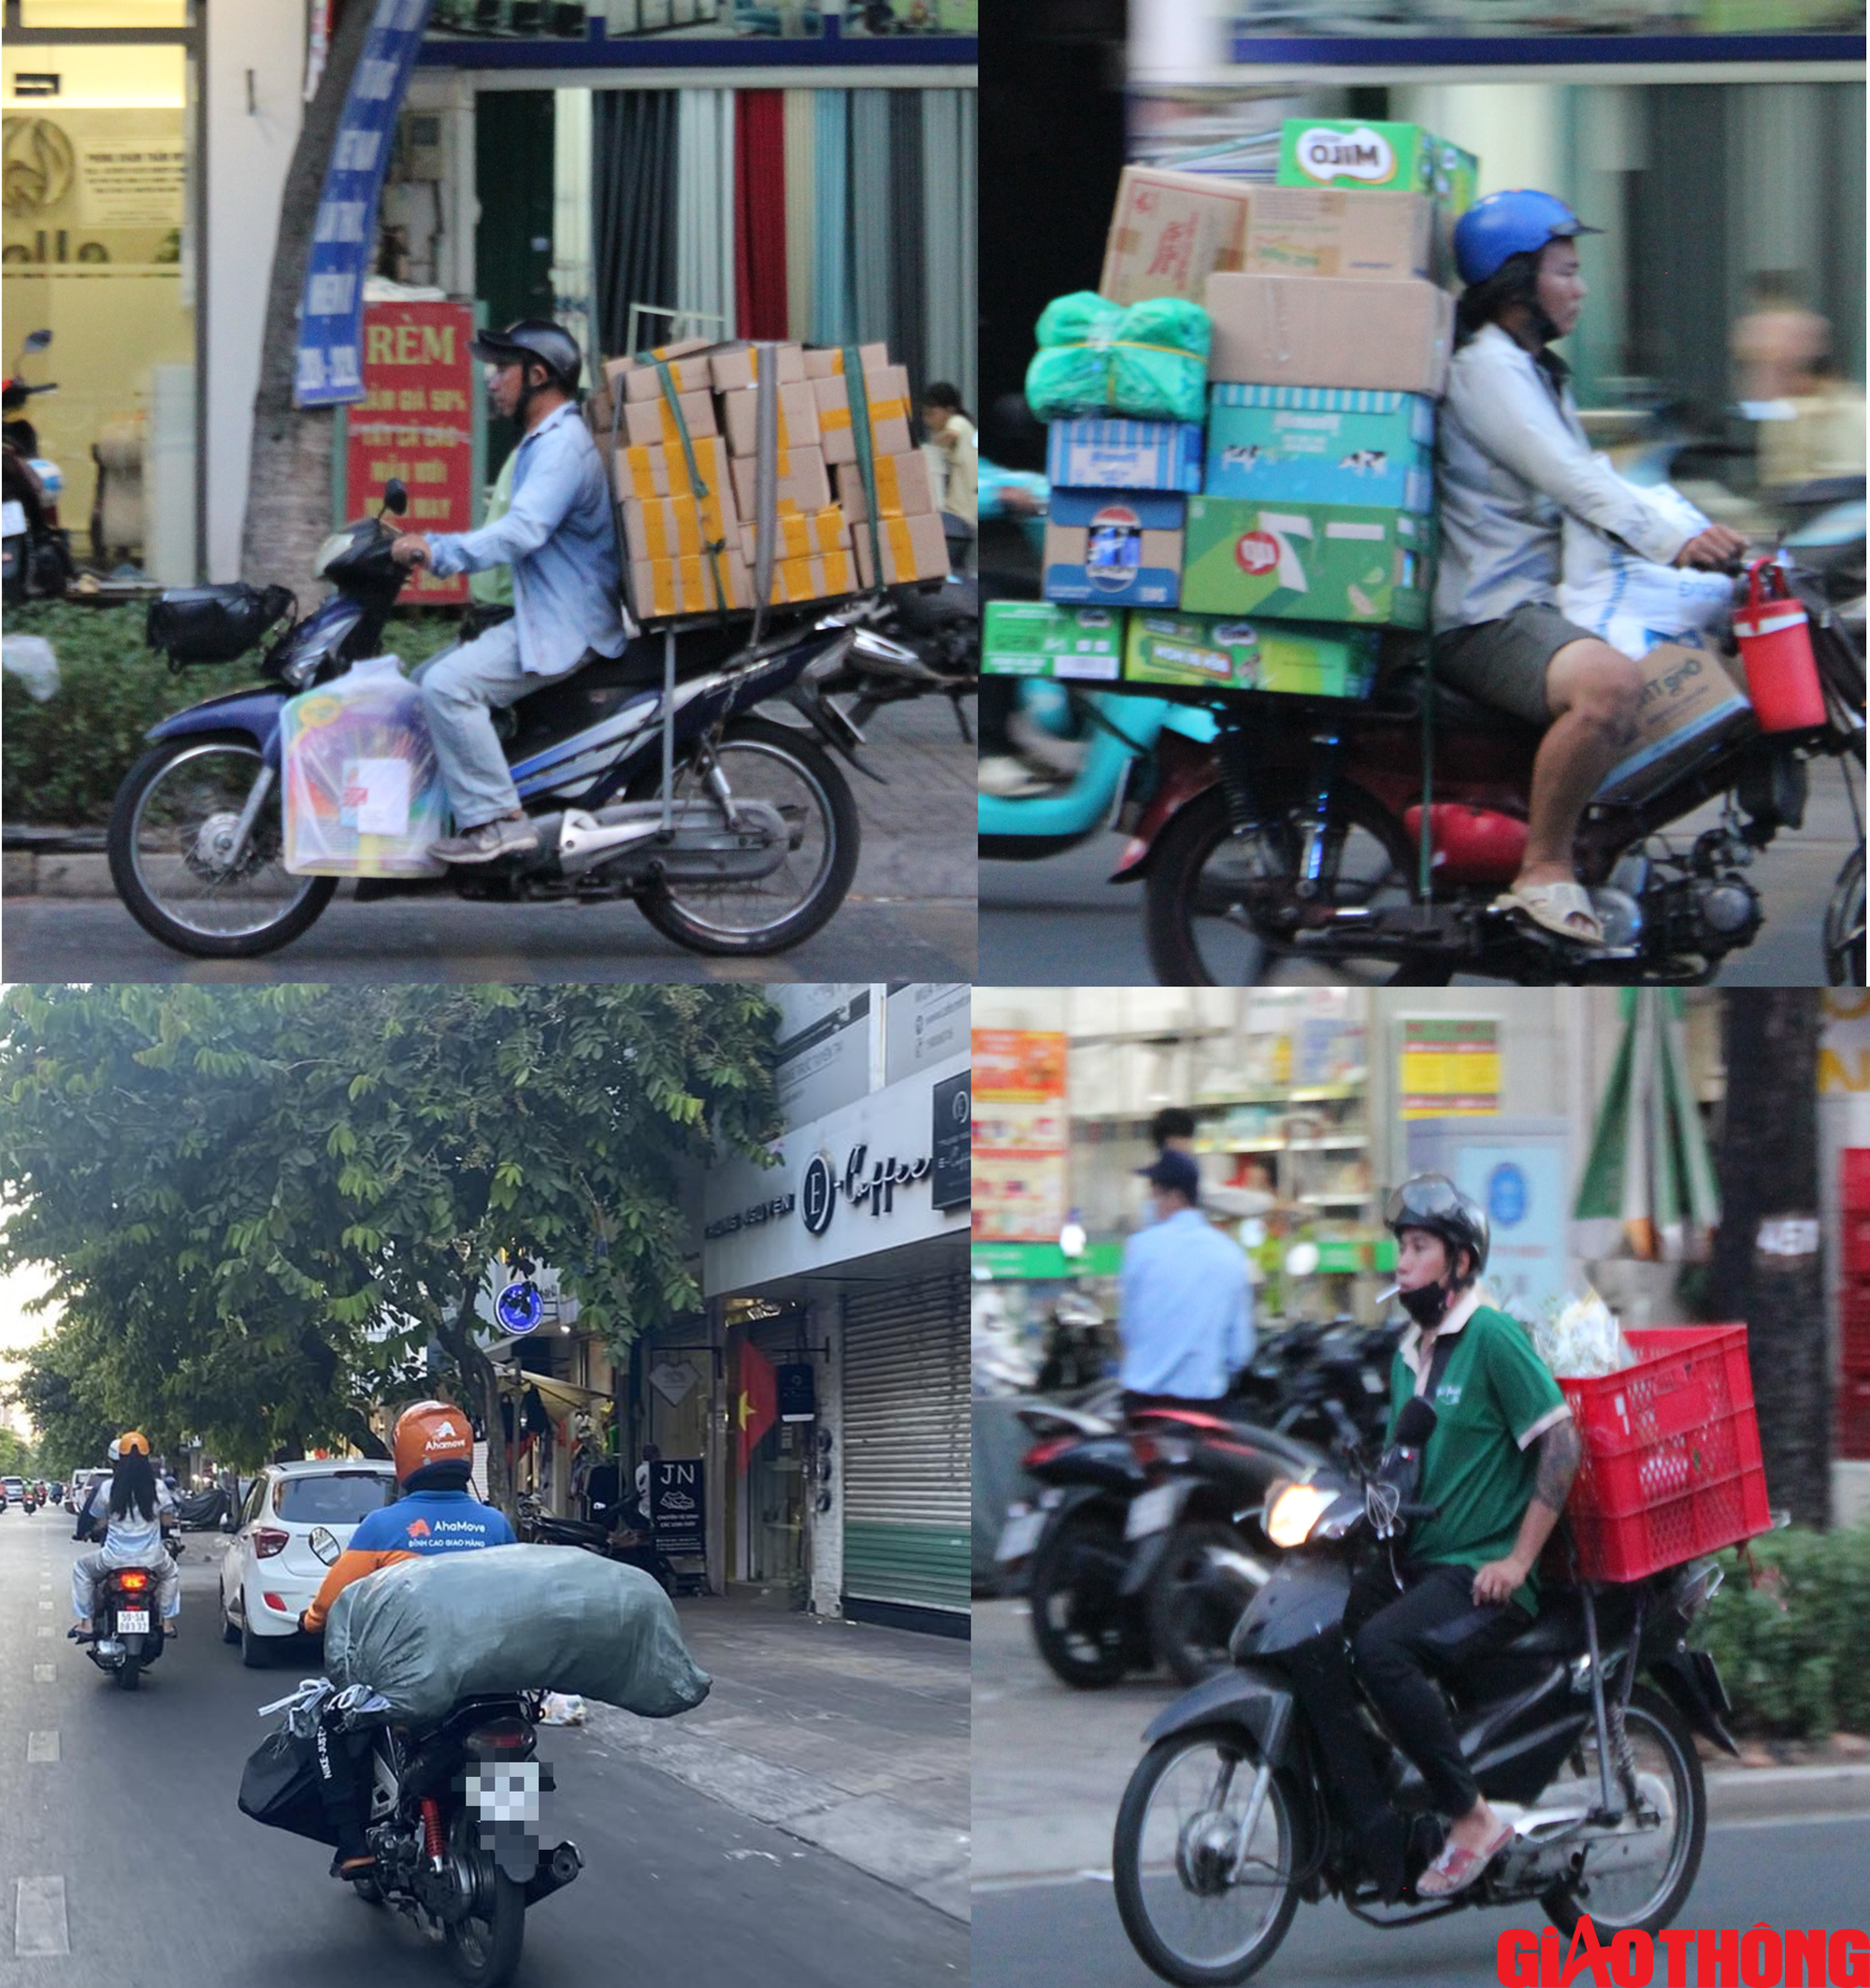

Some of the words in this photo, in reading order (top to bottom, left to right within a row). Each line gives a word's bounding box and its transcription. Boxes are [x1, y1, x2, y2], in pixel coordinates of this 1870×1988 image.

[367, 313, 454, 365] RÈM
[425, 1438, 466, 1451] Ahamove
[660, 1463, 695, 1485] JN
[434, 1520, 486, 1534] AhaMove
[428, 1539, 443, 1548] CAO
[445, 1539, 464, 1548] GIAO
